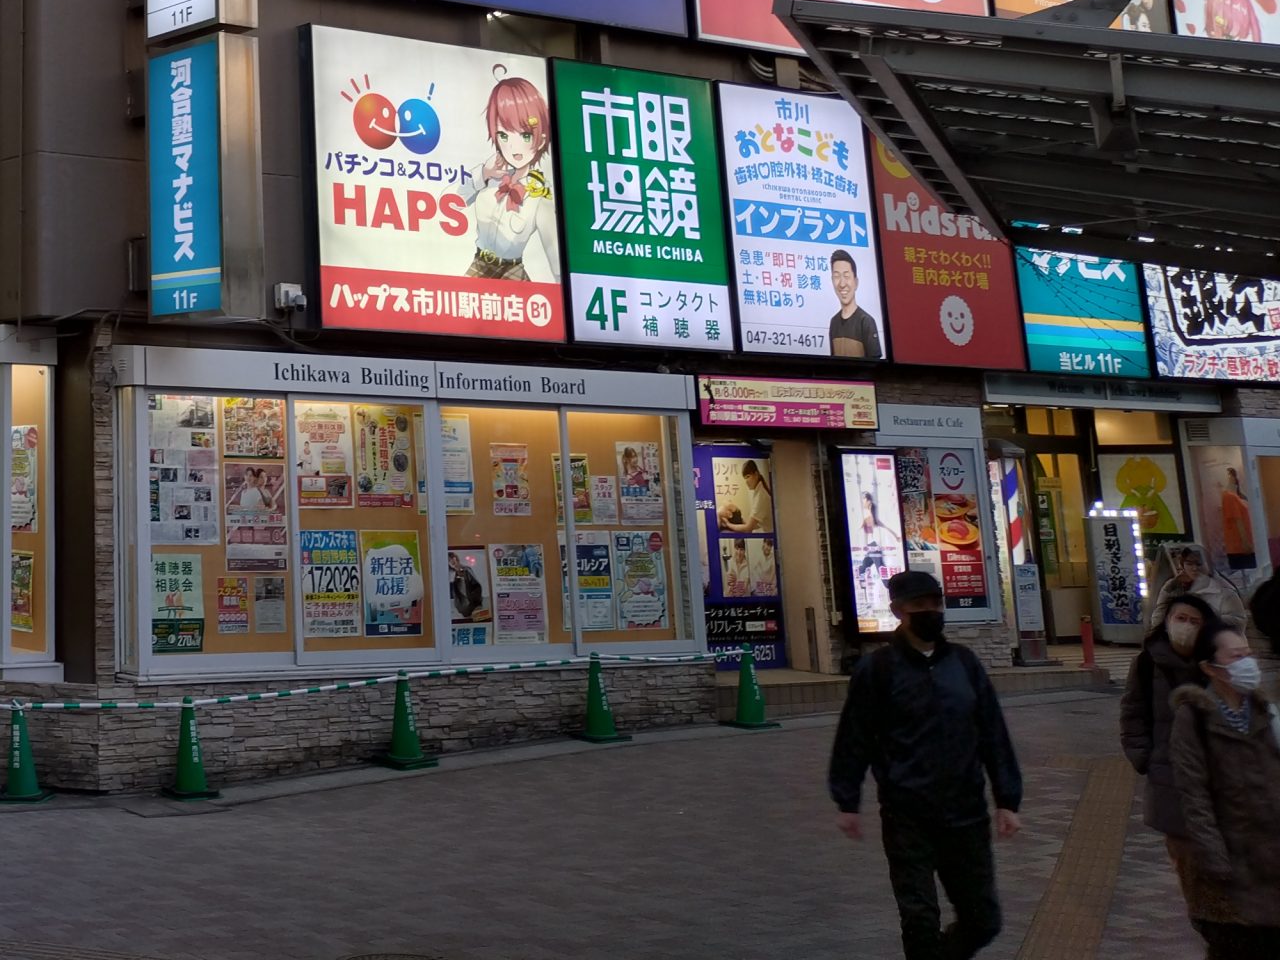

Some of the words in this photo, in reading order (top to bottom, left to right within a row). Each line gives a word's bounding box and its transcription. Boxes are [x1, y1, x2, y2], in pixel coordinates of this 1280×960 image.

[171, 5, 193, 26] 11F
[775, 98, 809, 124] 市川
[734, 123, 849, 171] おとなこども
[169, 57, 195, 262] 河合塾マナビス
[325, 151, 473, 185] パチンコ&スロット
[332, 182, 469, 237] HAPS
[735, 203, 866, 244] インプラント
[593, 239, 652, 258] MEGANE
[656, 245, 703, 263] ICHIBA
[797, 274, 822, 291] 診療
[912, 266, 989, 290] 屋内あそび場
[172, 290, 198, 310] 11F
[330, 283, 525, 323] ハップス市川駅前店
[529, 298, 549, 321] B1
[585, 286, 628, 331] 4F
[640, 289, 719, 313] コンタクト
[746, 330, 825, 348] 047-321-4617
[274, 362, 351, 384] Ichikawa
[361, 367, 430, 392] Building
[438, 371, 532, 394] Information
[541, 376, 586, 396] Board
[893, 415, 932, 427] Restaurant
[935, 418, 944, 428] &
[946, 417, 964, 428] Cafe
[938, 467, 967, 478] スシロー
[715, 484, 740, 496] エステ
[154, 561, 193, 576] 補聴器
[370, 556, 413, 575] 新生活
[155, 578, 193, 593] 相談会
[375, 577, 405, 596] 応援
